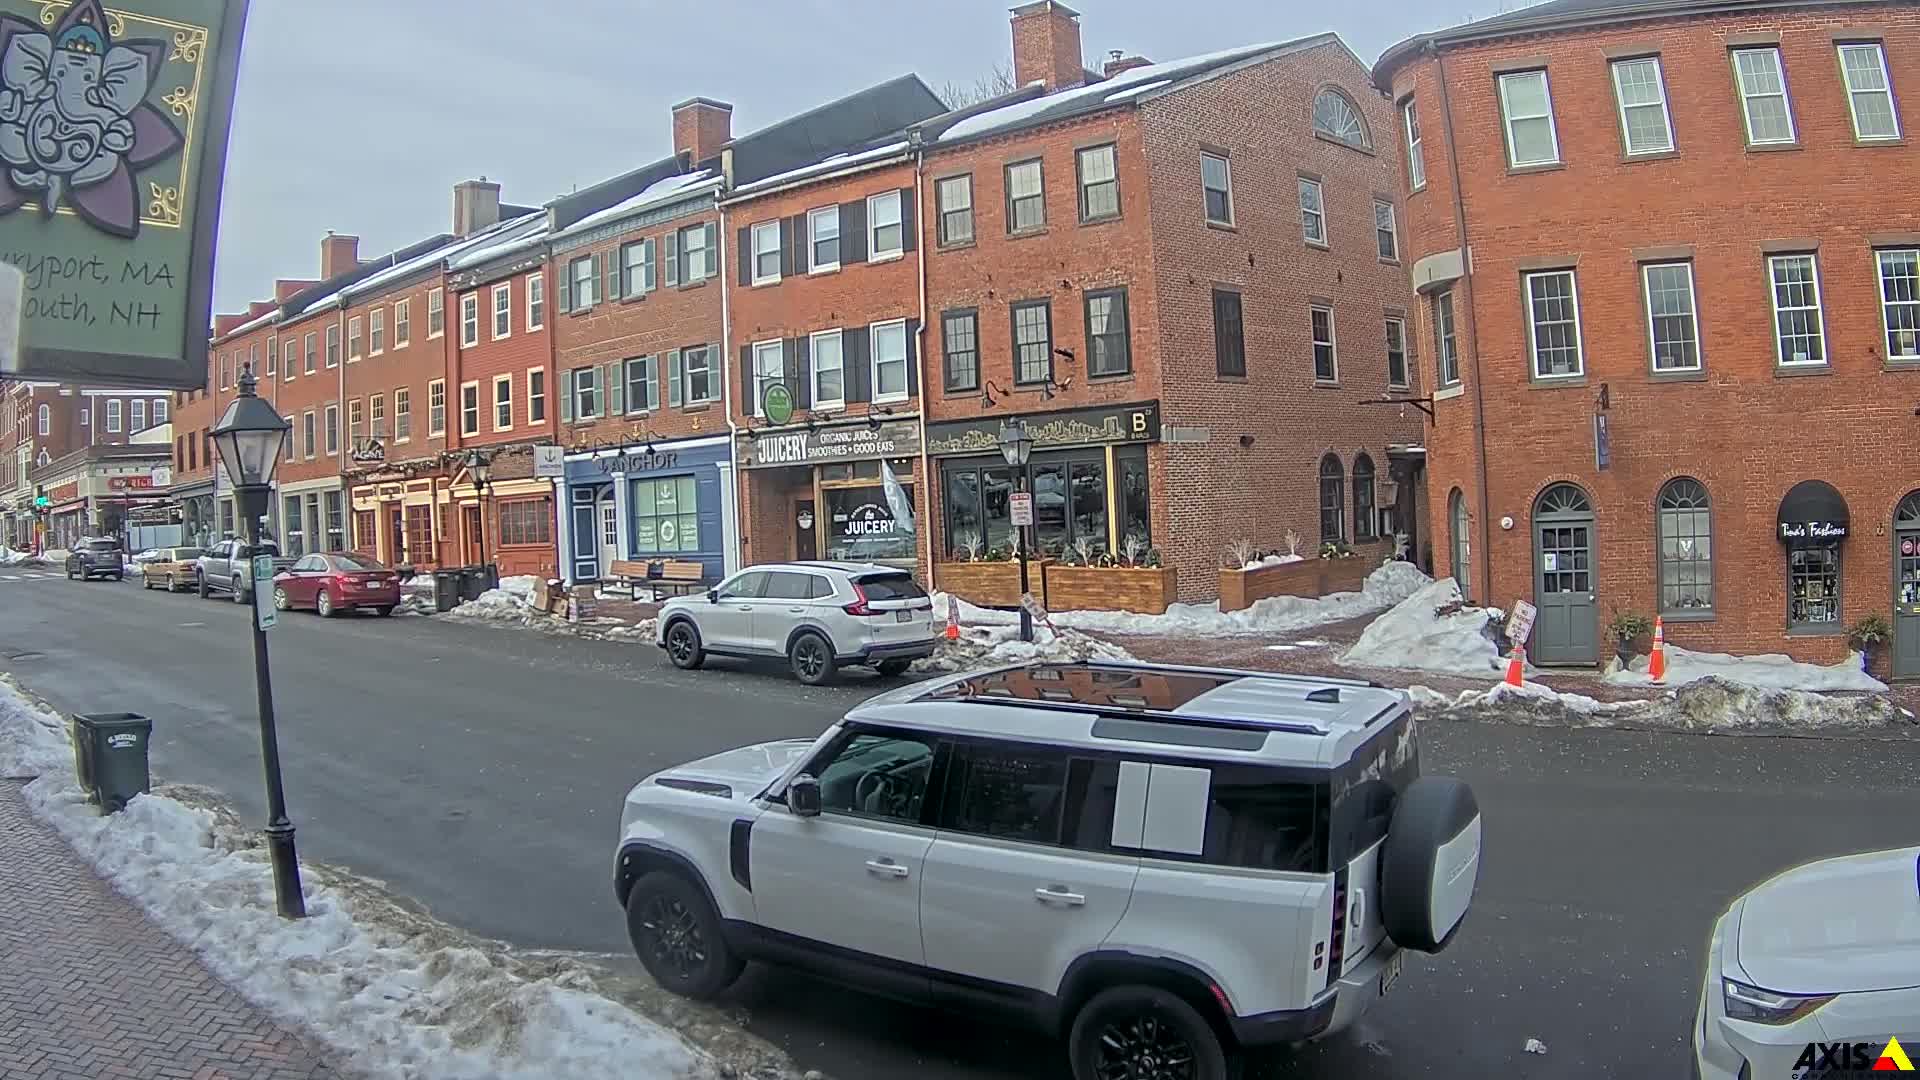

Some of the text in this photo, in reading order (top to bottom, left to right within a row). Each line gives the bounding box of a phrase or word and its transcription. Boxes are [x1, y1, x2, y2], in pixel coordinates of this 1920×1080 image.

[120, 260, 175, 288] MA
[110, 301, 161, 328] NH
[757, 433, 808, 464] JUICERY
[807, 440, 895, 458] SMOOTHIES GOOD EATS
[820, 433, 852, 444] ORGANIC
[609, 451, 678, 473] ANCHOR
[845, 519, 895, 535] JUICERY
